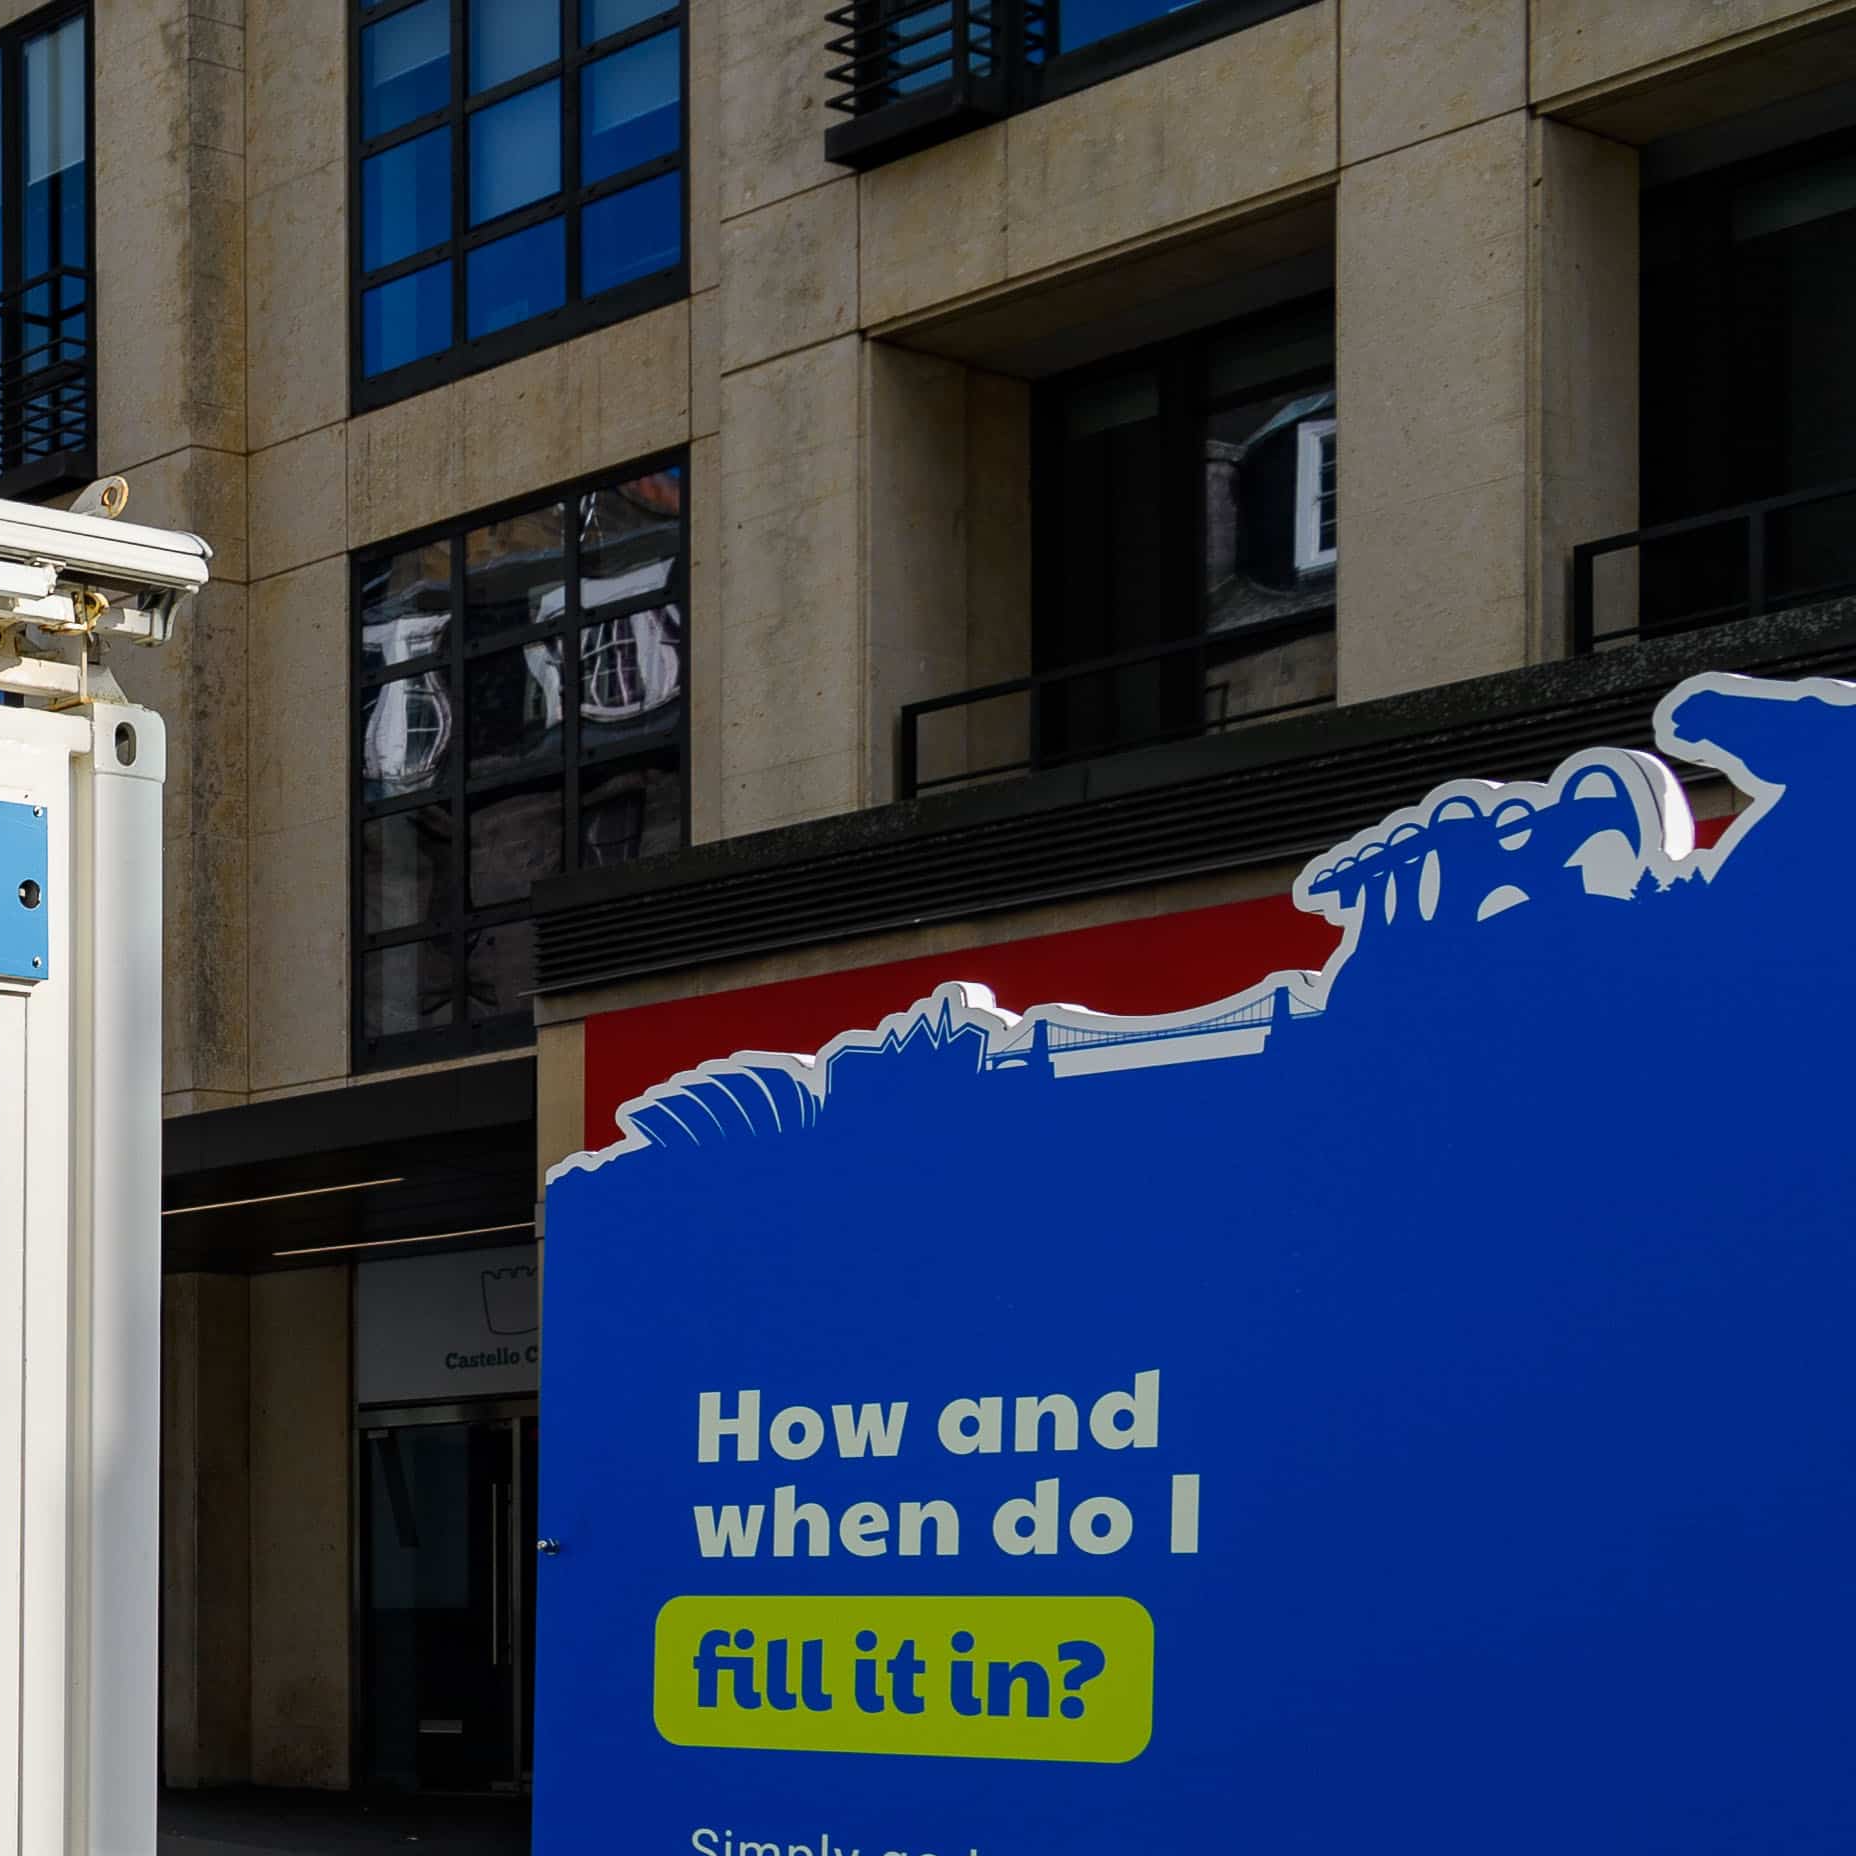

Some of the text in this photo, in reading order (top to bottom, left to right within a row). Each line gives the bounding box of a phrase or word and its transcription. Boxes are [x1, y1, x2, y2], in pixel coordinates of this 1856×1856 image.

[445, 1347, 520, 1370] Castello
[697, 1368, 1160, 1463] How and
[693, 1473, 1200, 1558] when do I
[693, 1628, 1107, 1719] fill it in?
